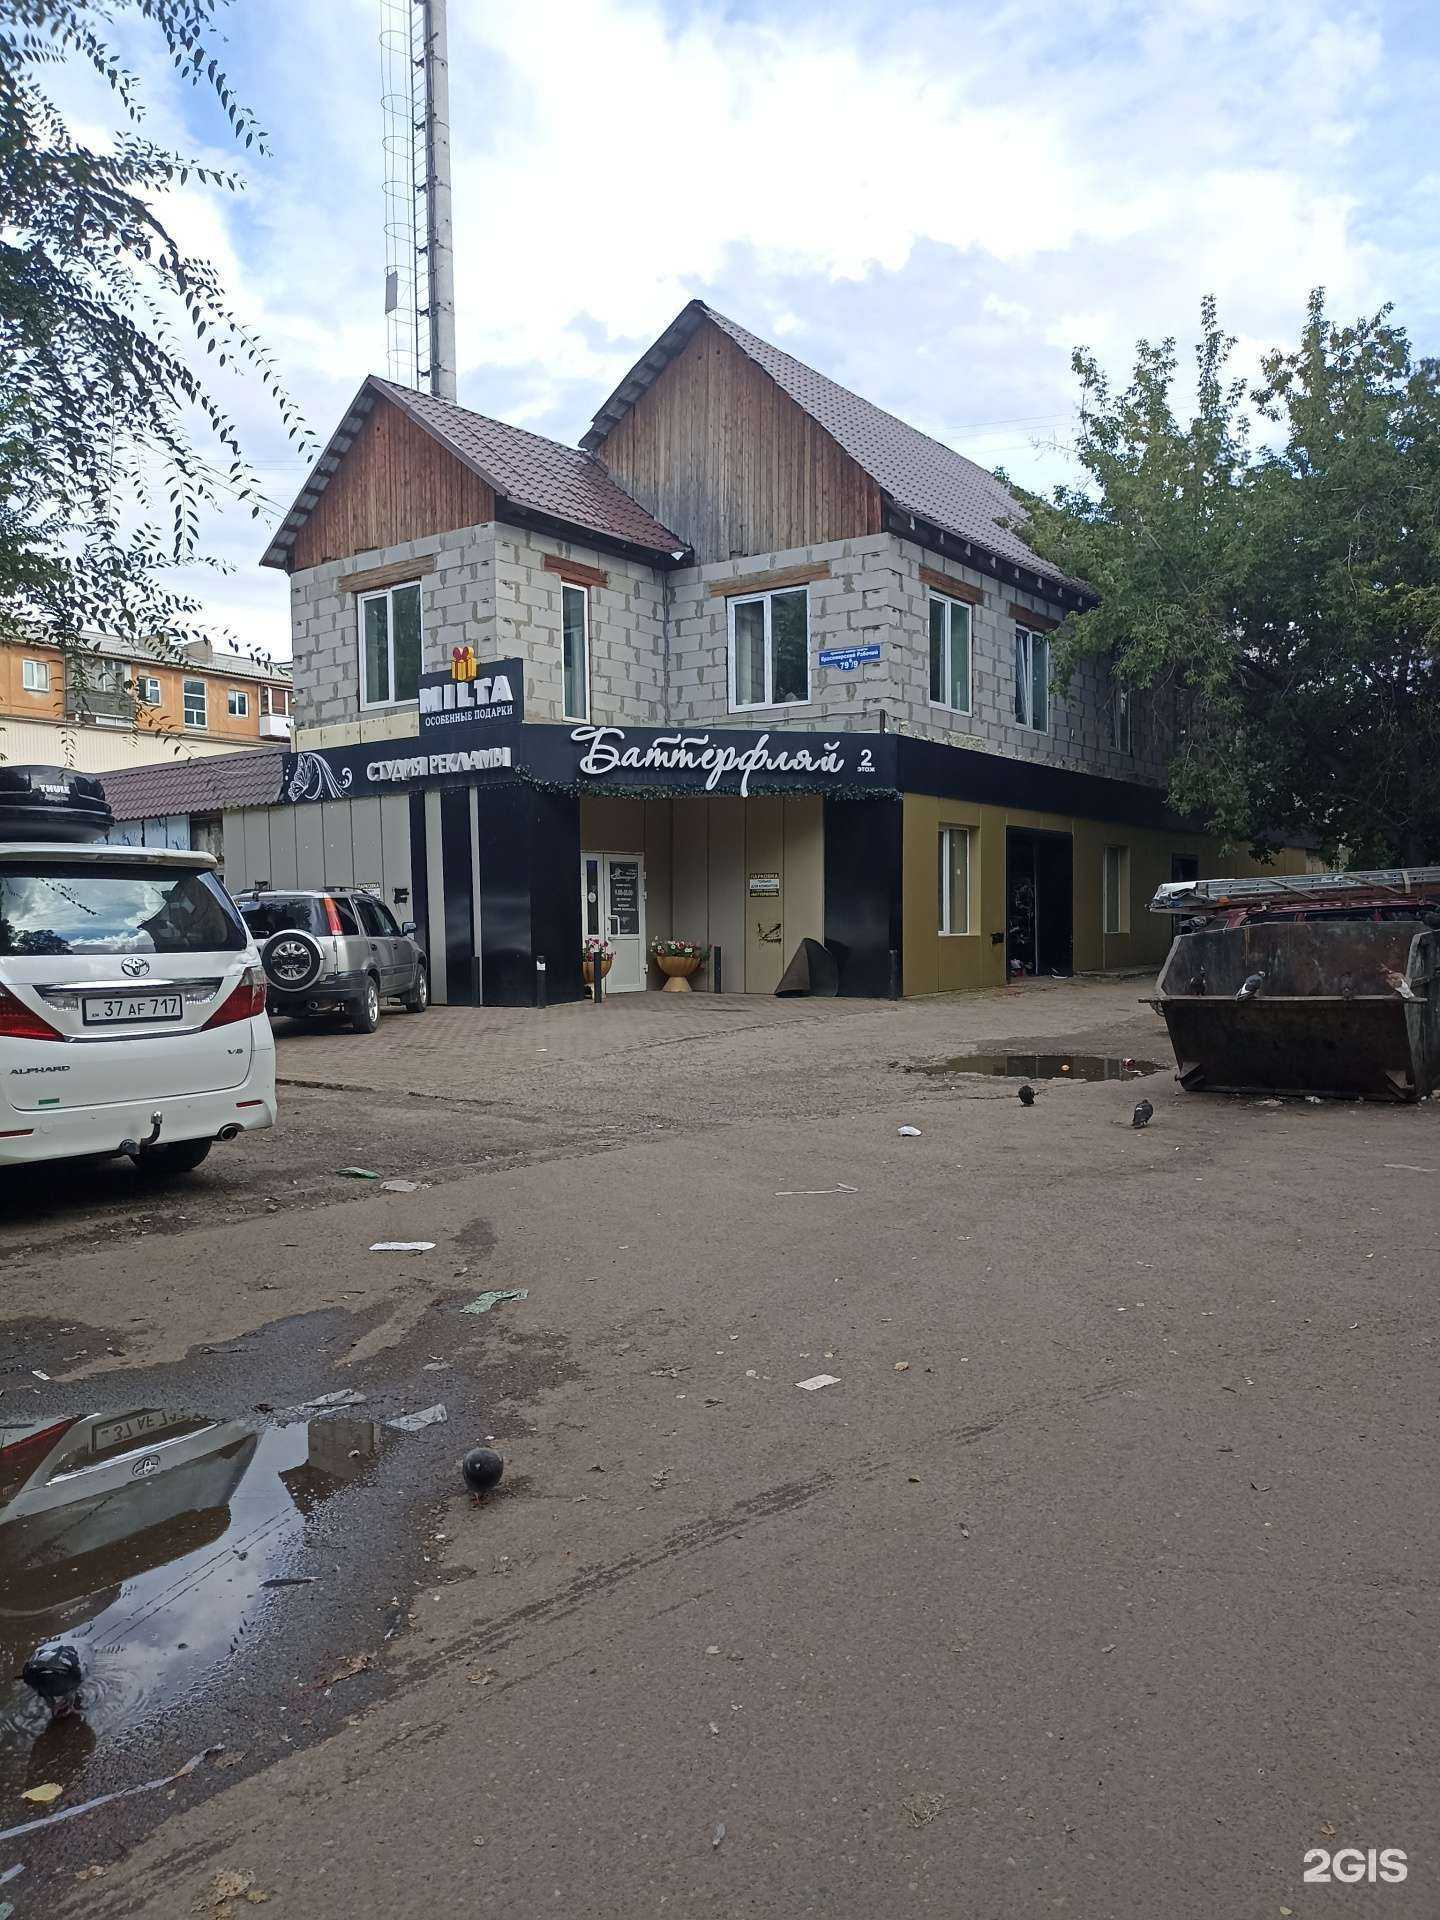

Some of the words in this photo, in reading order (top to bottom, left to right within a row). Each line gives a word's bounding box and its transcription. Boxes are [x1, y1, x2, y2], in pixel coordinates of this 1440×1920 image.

[419, 675, 514, 714] MILTA
[425, 713, 473, 727] ОСОБЕННЫЕ
[474, 705, 513, 720] ПОДАРКИ
[366, 756, 429, 782] СТУДИЯ
[429, 747, 512, 775] РЕКЛАМЫ
[570, 725, 845, 798] Баттерфляй
[860, 749, 872, 766] 2
[40, 784, 71, 794] THULE
[104, 1001, 123, 1017] 37
[128, 1003, 146, 1016] AF
[150, 998, 177, 1015] 717
[9, 1065, 71, 1075] ALPHARD
